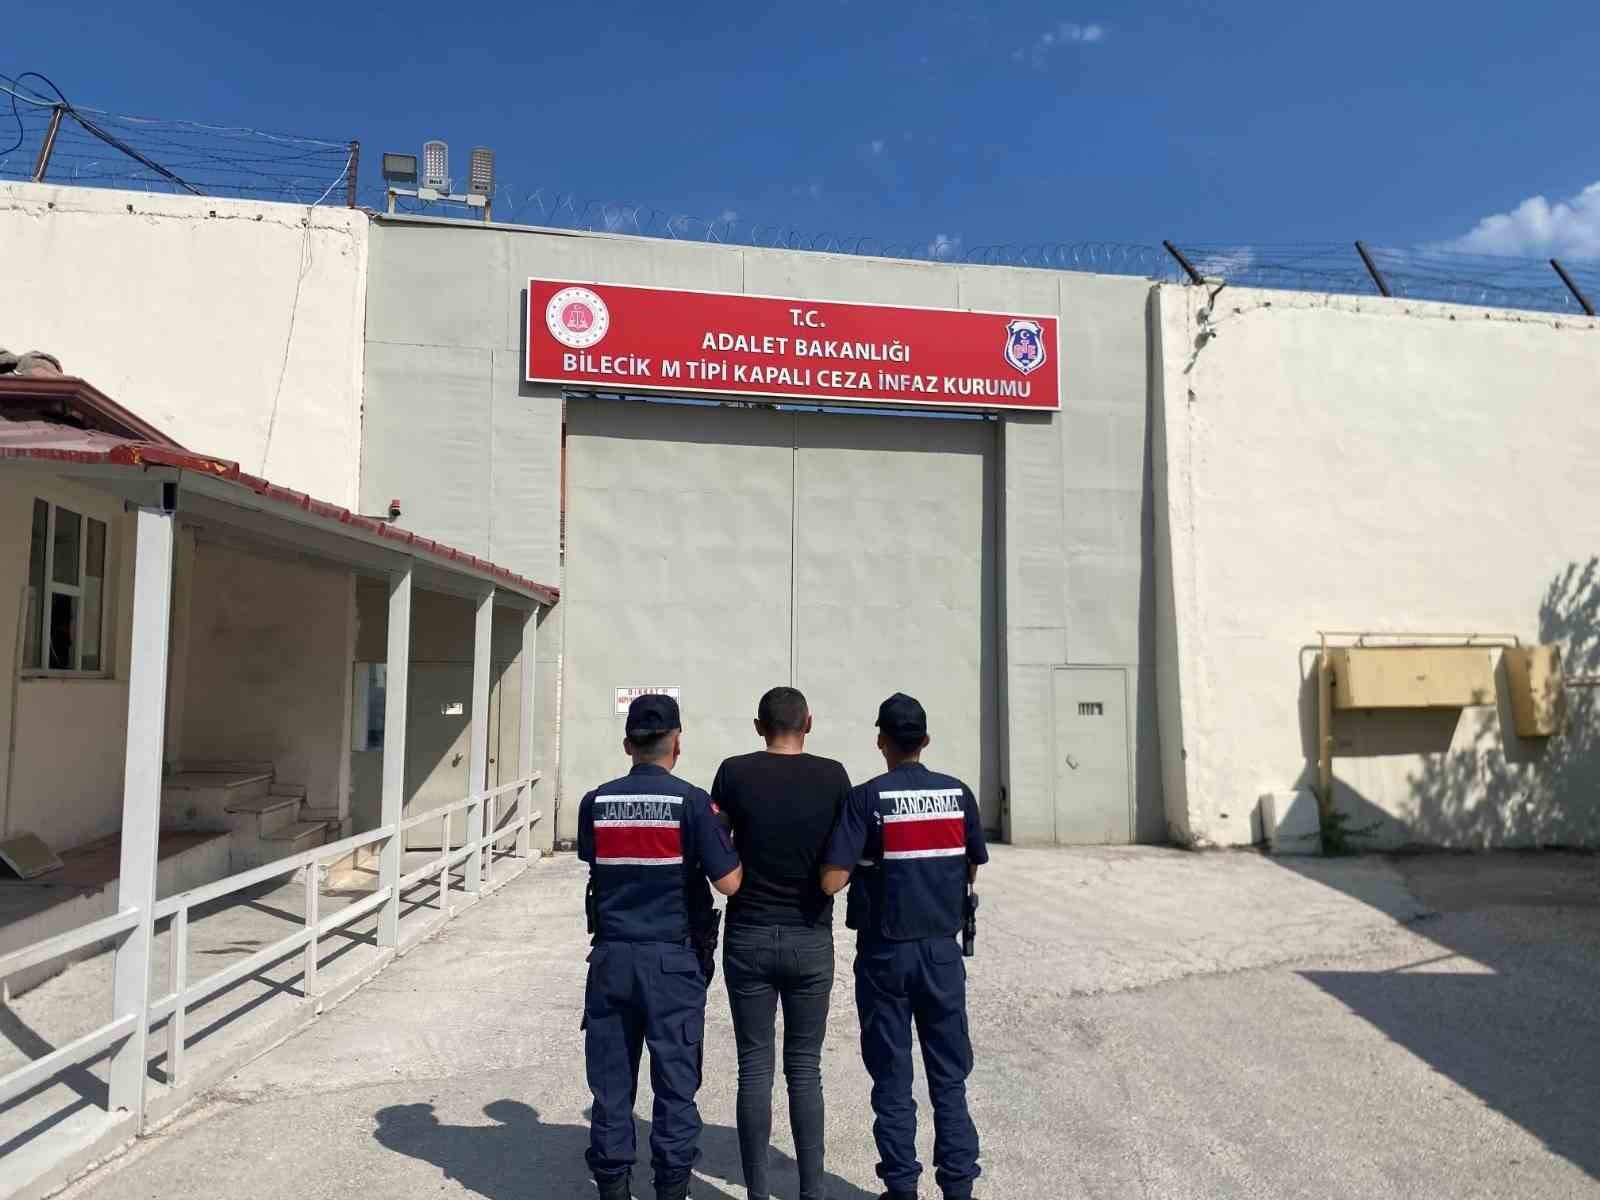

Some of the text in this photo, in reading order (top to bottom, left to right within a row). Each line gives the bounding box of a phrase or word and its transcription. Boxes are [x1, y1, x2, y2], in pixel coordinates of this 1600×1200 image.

[789, 308, 826, 328] T.C.
[702, 332, 910, 363] ADALET BAKANLIĞI
[563, 350, 1031, 398] BİLECİK M TİPİ KAPALI CEZA İNFAZ KURUMU
[601, 802, 673, 820] JANDARMA
[891, 795, 960, 815] JANDARMA
